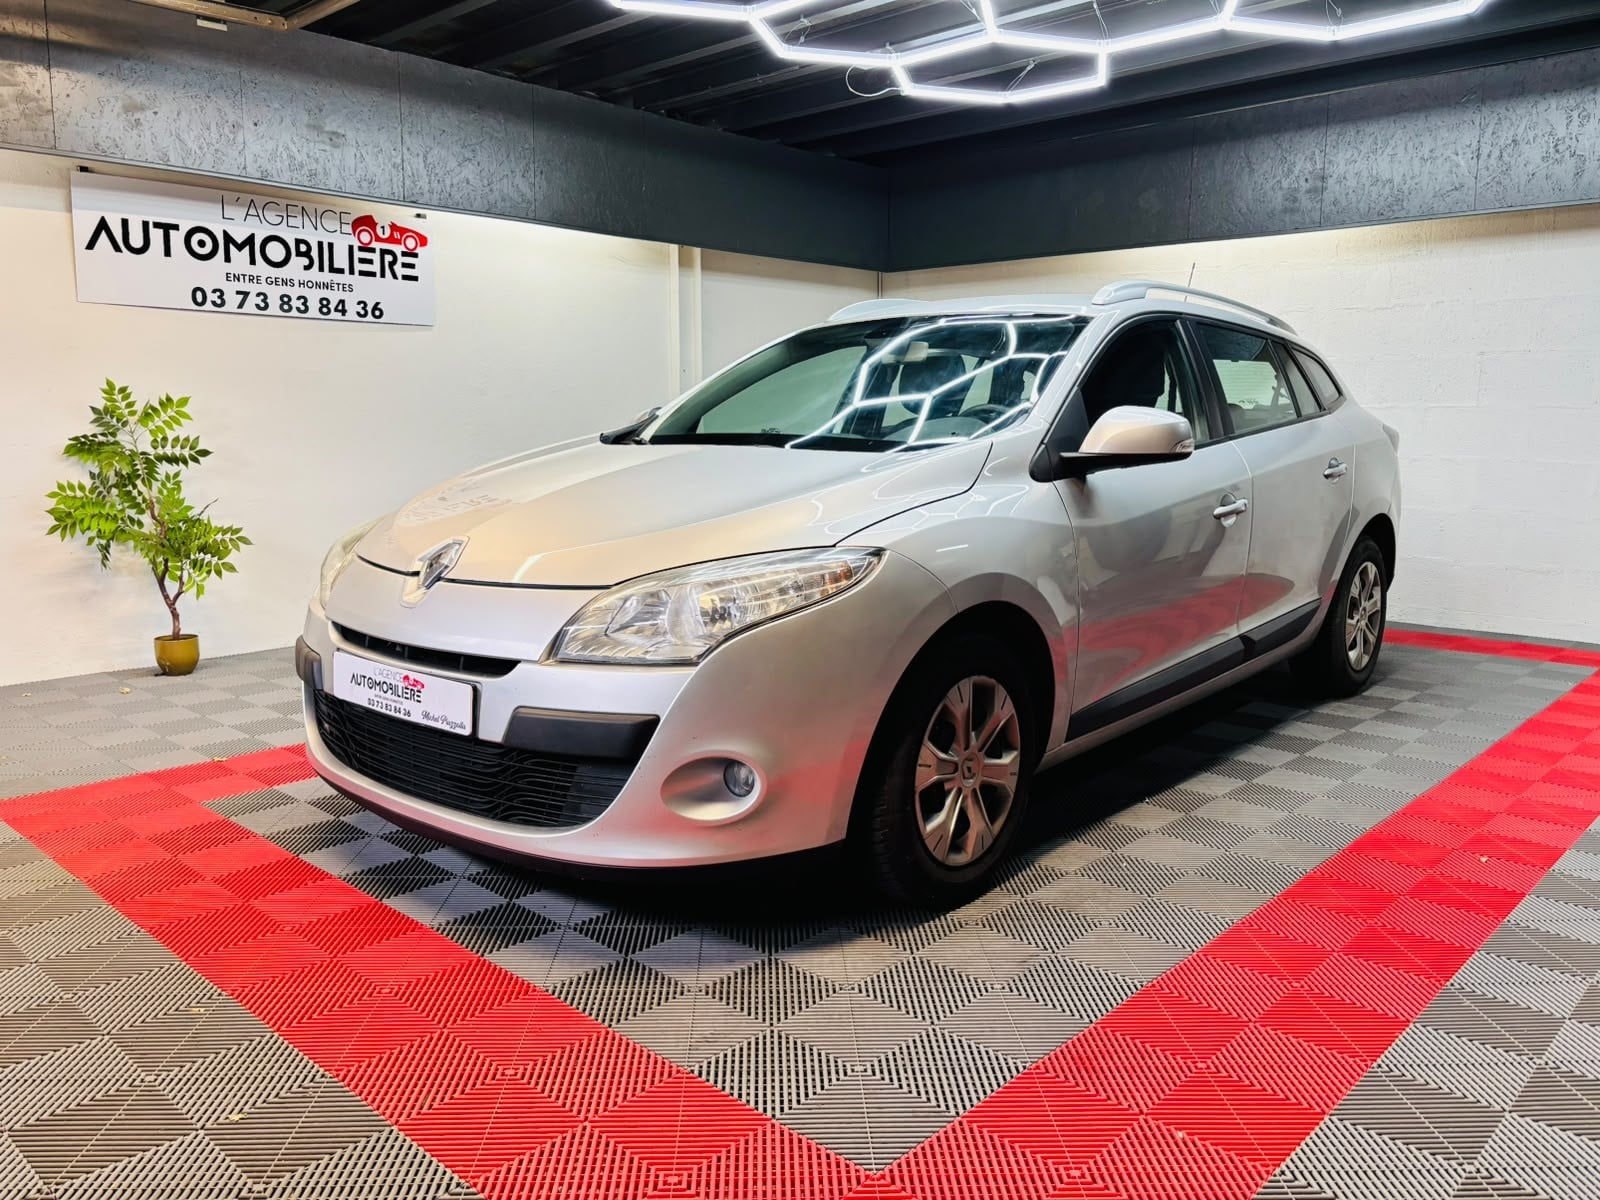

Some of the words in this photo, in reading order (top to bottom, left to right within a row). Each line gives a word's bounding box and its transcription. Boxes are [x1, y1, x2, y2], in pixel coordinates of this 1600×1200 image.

[380, 225, 385, 235] 1
[225, 272, 263, 285] ENTRE
[265, 276, 295, 289] GENS
[298, 279, 354, 293] HONNÊTES
[191, 286, 226, 308] 03
[236, 290, 270, 312] 73
[279, 294, 310, 316] 83
[318, 297, 348, 317] 84
[356, 300, 384, 320] 36
[367, 698, 375, 707] 03
[376, 699, 384, 708] 73
[385, 703, 392, 712] 83
[393, 706, 401, 714] 84
[402, 708, 411, 717] 36
